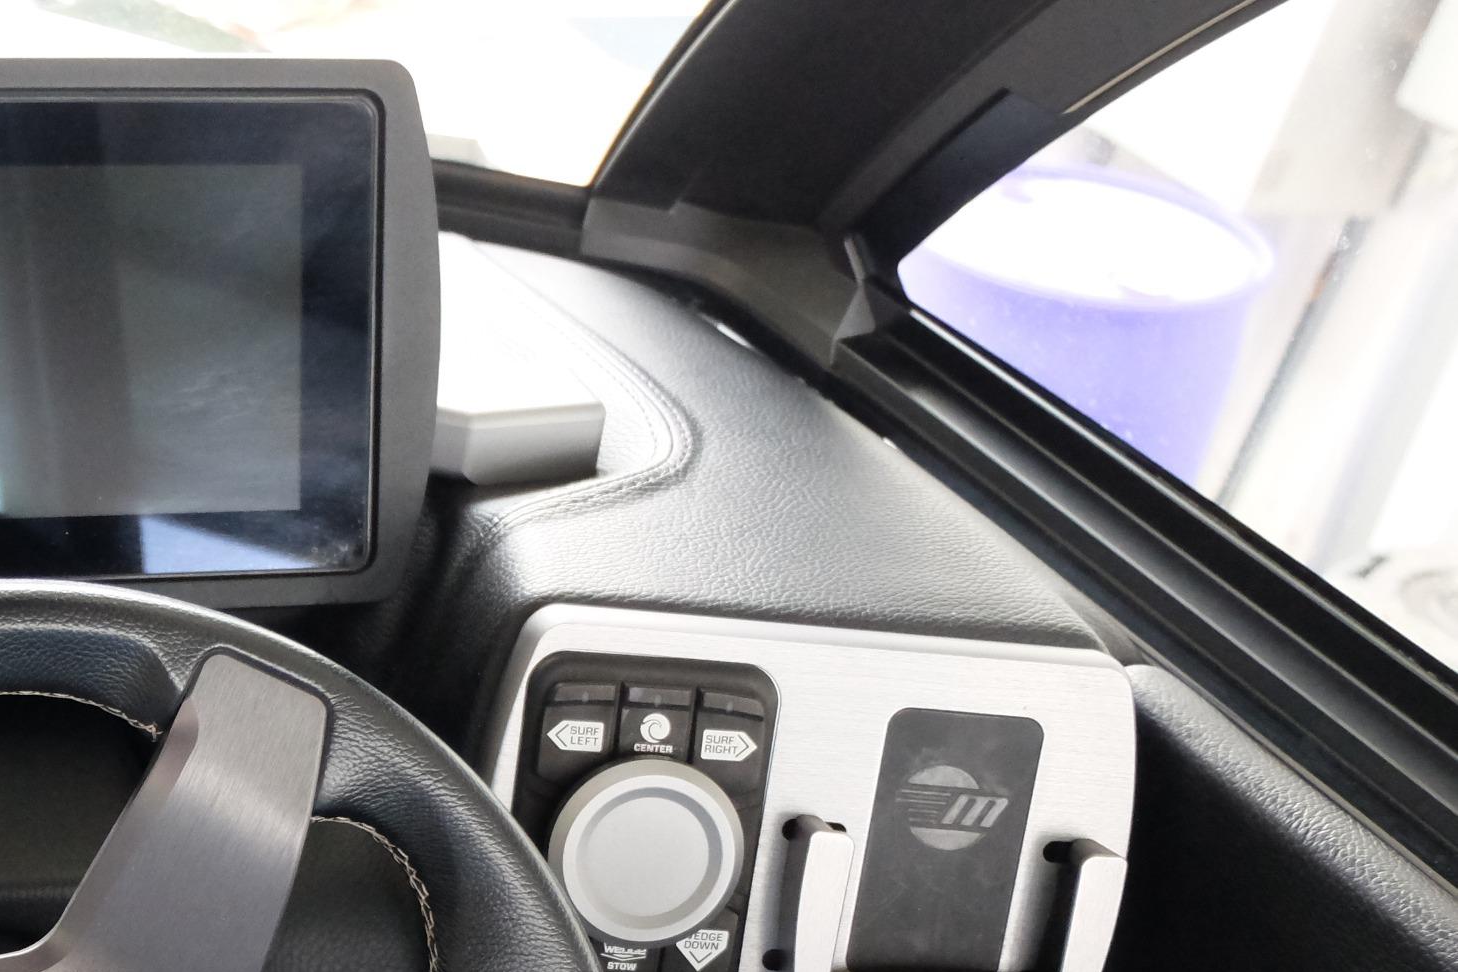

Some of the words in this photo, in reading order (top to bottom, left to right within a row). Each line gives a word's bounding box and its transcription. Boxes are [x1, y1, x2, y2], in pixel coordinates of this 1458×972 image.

[570, 725, 600, 736] SURF
[569, 735, 599, 747] LEFT
[705, 734, 735, 745] SURF
[633, 743, 673, 754] CENTER
[704, 744, 738, 755] RIGHT
[684, 940, 719, 950] DOWN
[606, 961, 638, 972] STOW
